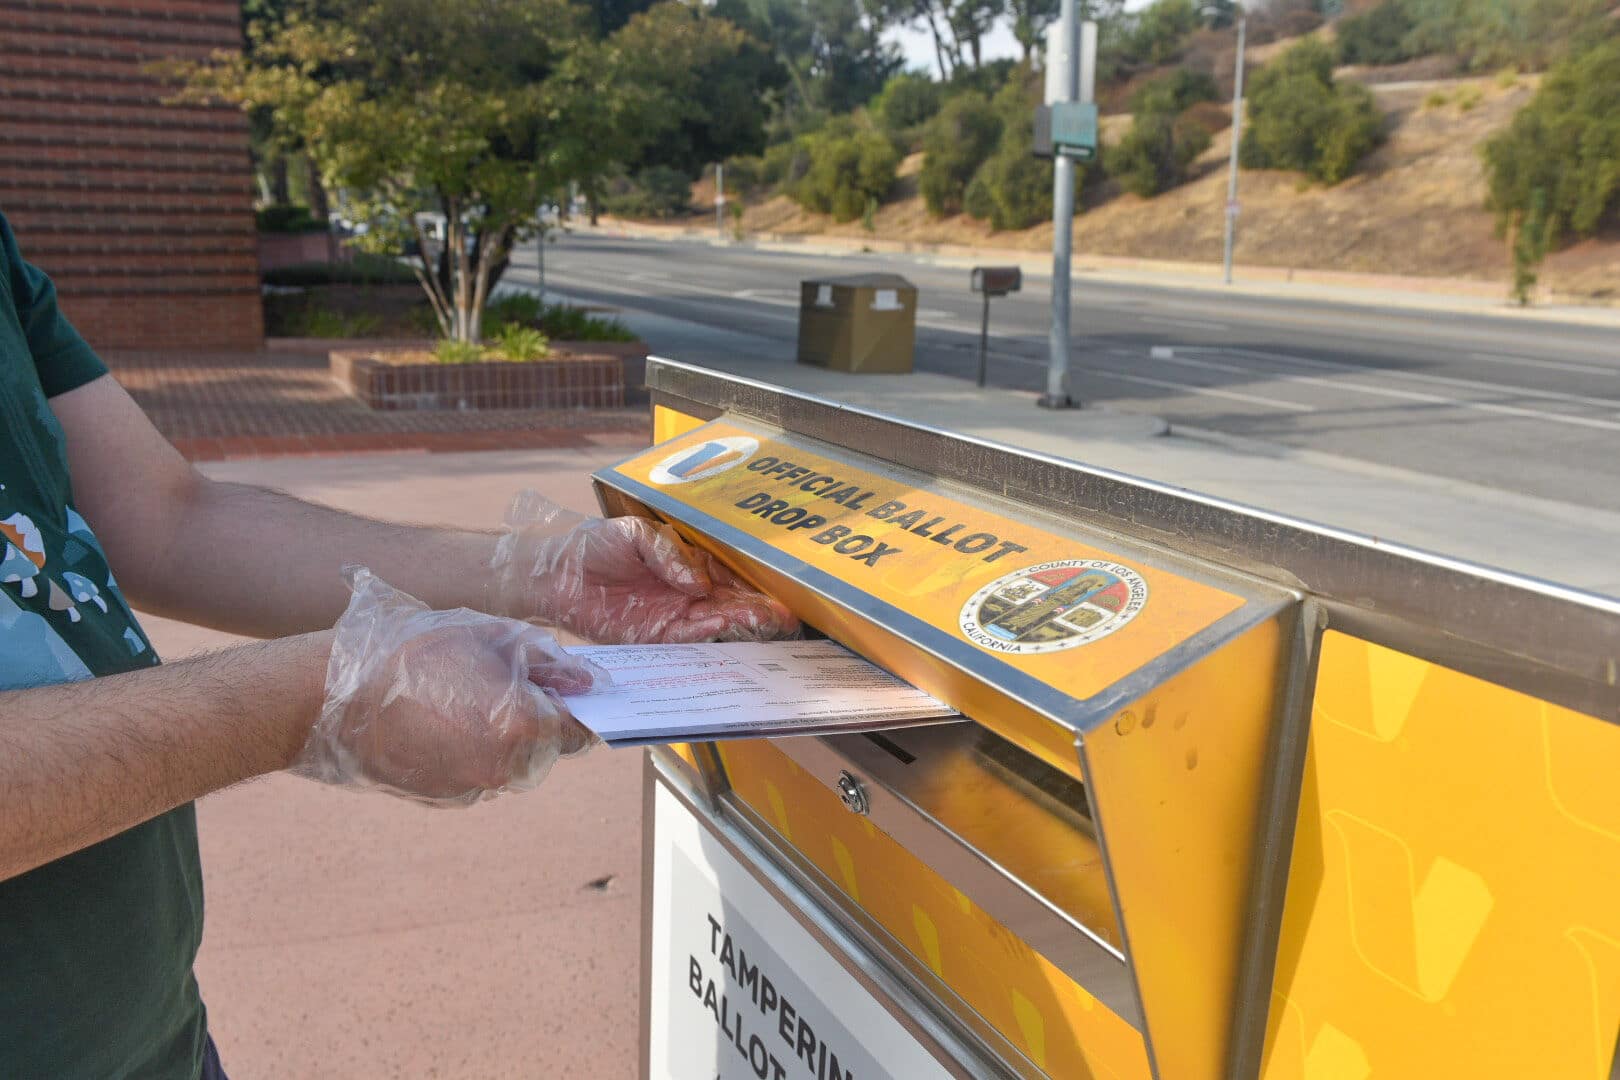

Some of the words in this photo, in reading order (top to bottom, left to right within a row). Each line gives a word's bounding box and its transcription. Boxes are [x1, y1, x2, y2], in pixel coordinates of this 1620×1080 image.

[734, 492, 827, 532] DROP
[811, 522, 903, 567] BOX
[746, 456, 873, 511] OFFICIAL
[865, 500, 1030, 563] BALLOT
[1029, 560, 1087, 573] COUNTY
[1091, 561, 1111, 569] OF
[1110, 565, 1133, 578] LOS
[1126, 577, 1145, 611] ANGELES
[963, 622, 1022, 652] CALIFORNIA
[689, 954, 786, 1080] BALLOT
